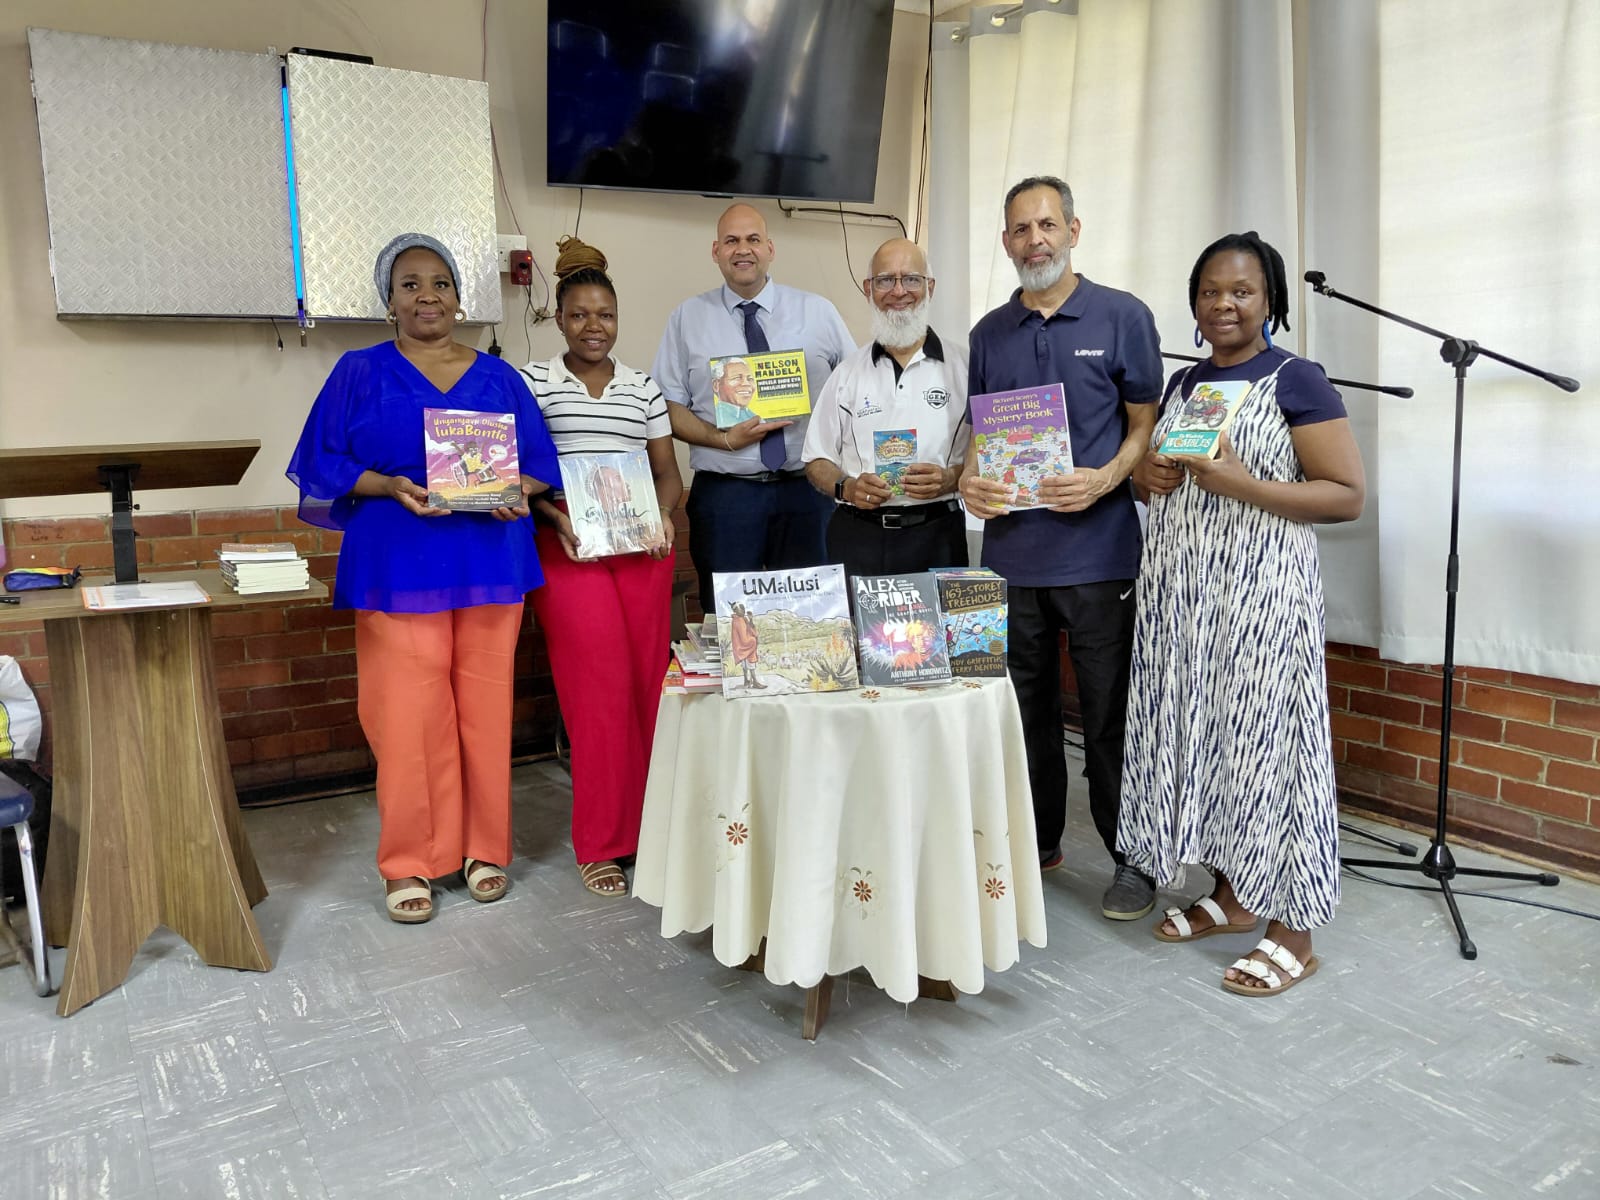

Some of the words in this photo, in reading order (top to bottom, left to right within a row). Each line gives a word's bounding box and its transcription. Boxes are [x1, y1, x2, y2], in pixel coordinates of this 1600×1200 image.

[757, 359, 798, 370] NELSON
[755, 367, 801, 378] MANDELA
[992, 403, 1020, 413] Great
[1023, 400, 1040, 410] Big
[983, 413, 1022, 426] Mystery
[1025, 407, 1054, 420] Book
[1166, 438, 1213, 448] WOMBLES
[742, 574, 820, 596] UMalusi
[857, 578, 898, 594] ALEX
[945, 580, 1001, 600] 169-STOREY
[878, 589, 924, 608] RIDER
[947, 590, 1004, 609] TREEHOUSE
[891, 669, 917, 679] ANTHONY
[918, 666, 949, 676] HOROWITZ
[974, 663, 1003, 672] DENTON
